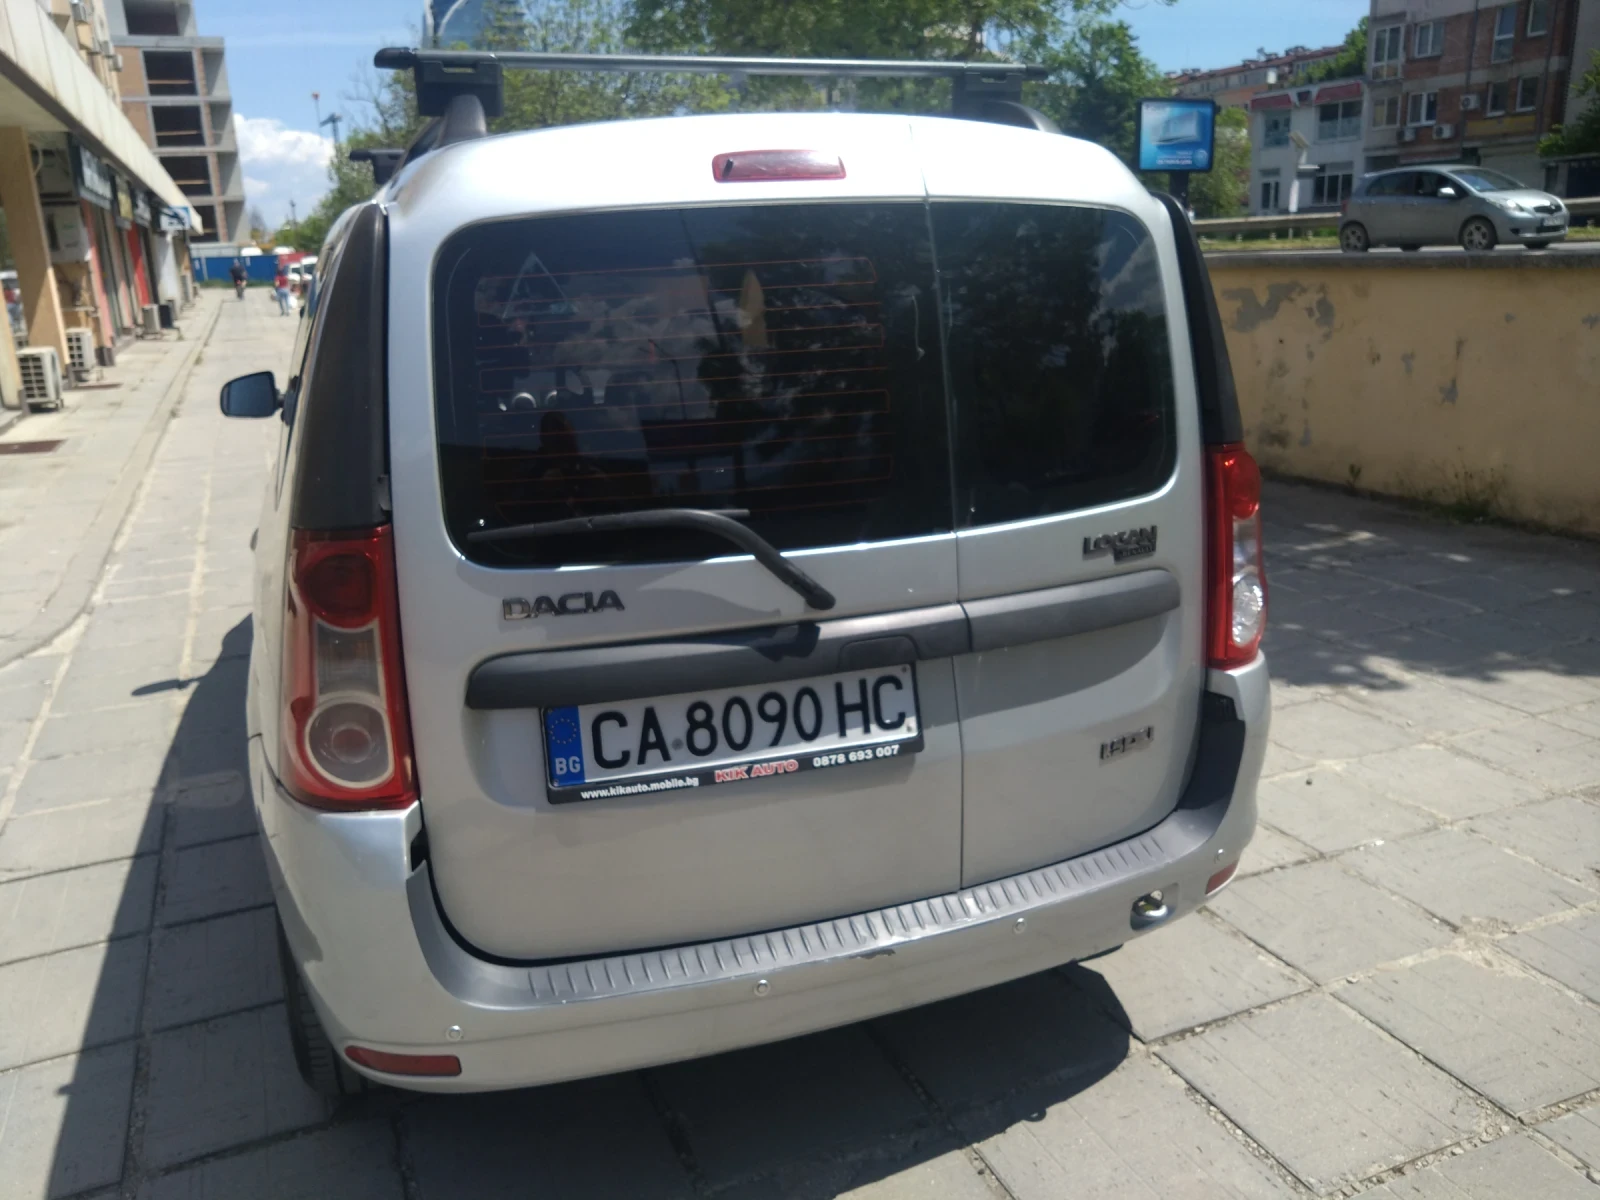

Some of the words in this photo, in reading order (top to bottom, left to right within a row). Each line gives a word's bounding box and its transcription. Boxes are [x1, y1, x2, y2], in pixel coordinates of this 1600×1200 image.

[502, 590, 625, 620] DACIA
[591, 706, 672, 770] CA
[685, 685, 823, 757] 8090
[834, 674, 906, 738] HC
[554, 757, 581, 775] BG
[813, 753, 845, 768] 0878
[849, 748, 873, 762] 693
[876, 744, 900, 758] 007
[715, 766, 749, 782] KIK
[751, 759, 799, 777] AUTO
[581, 776, 700, 799] www.kikauto.mobile.bg
